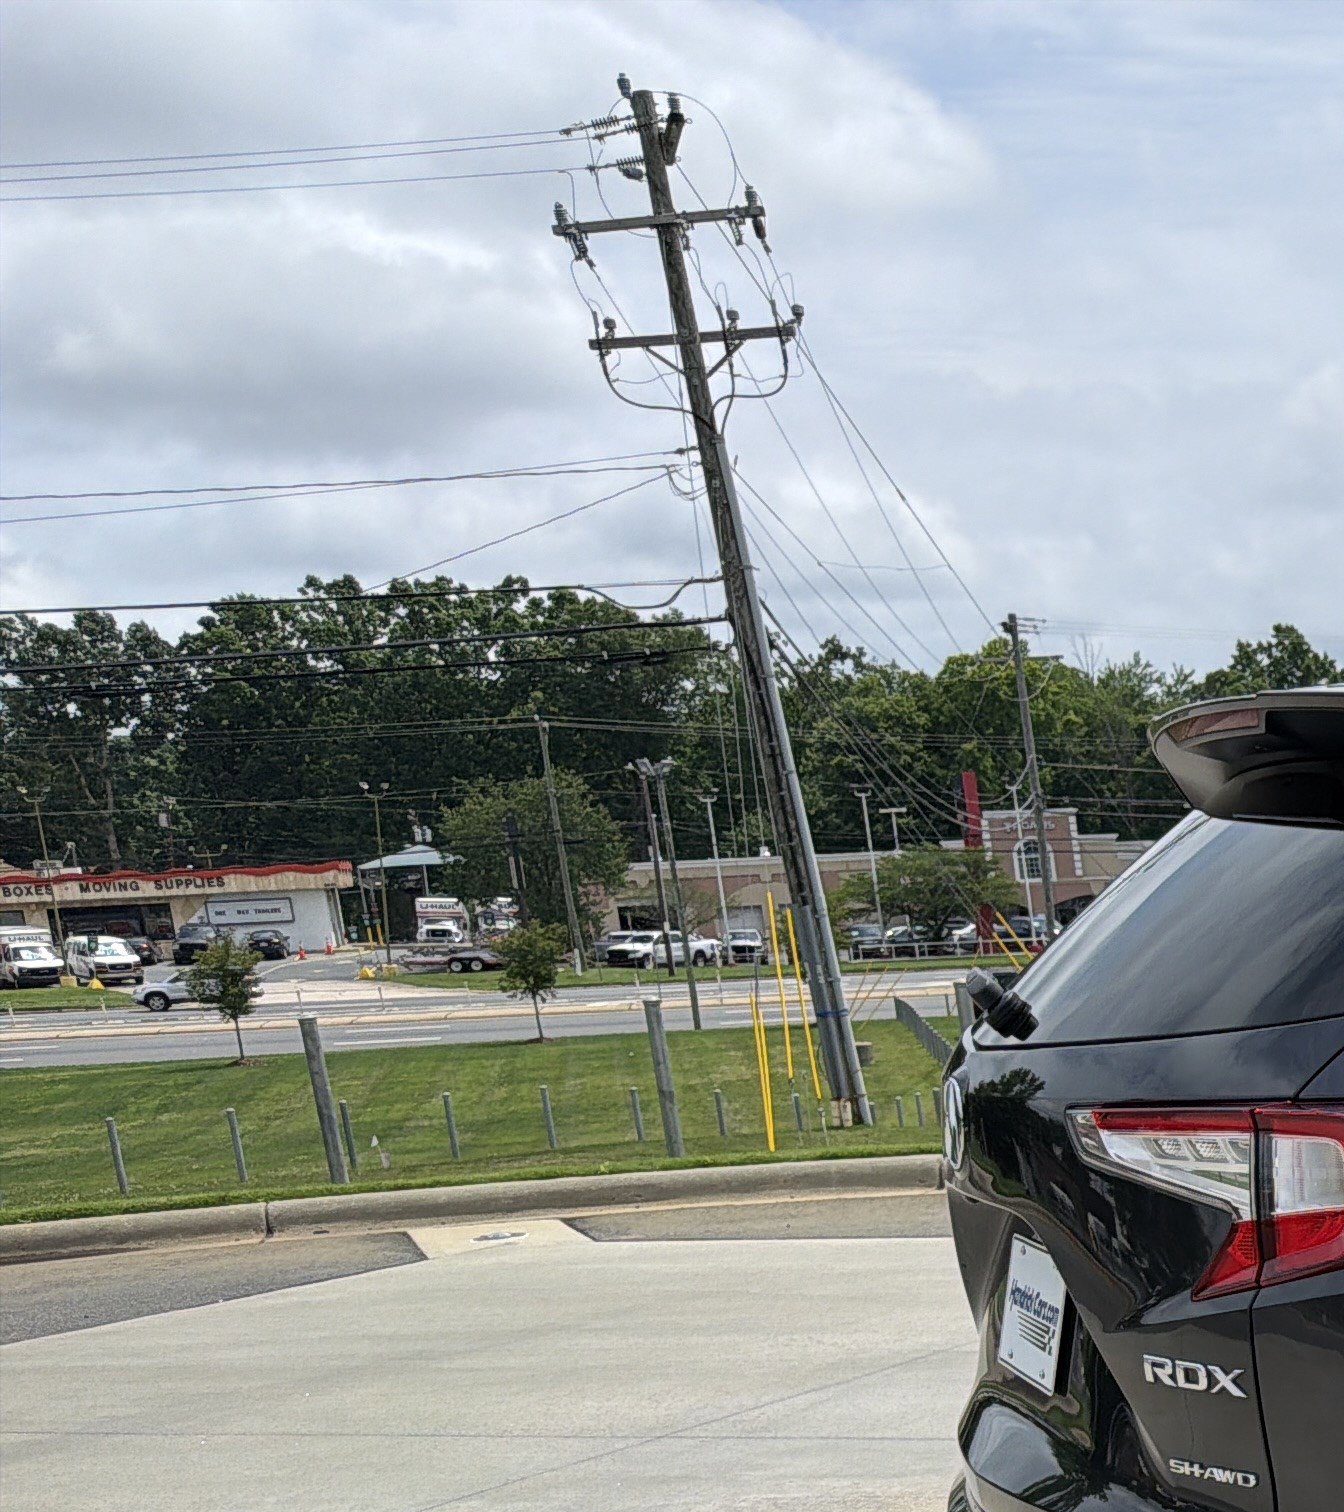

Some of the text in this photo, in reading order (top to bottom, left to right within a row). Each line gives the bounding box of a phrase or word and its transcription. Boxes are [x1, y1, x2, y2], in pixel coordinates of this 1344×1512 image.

[2, 876, 226, 898] BOXES MOVING SUPPLIES
[1142, 1353, 1248, 1398] RDX
[1168, 1458, 1258, 1488] SH-AWD
